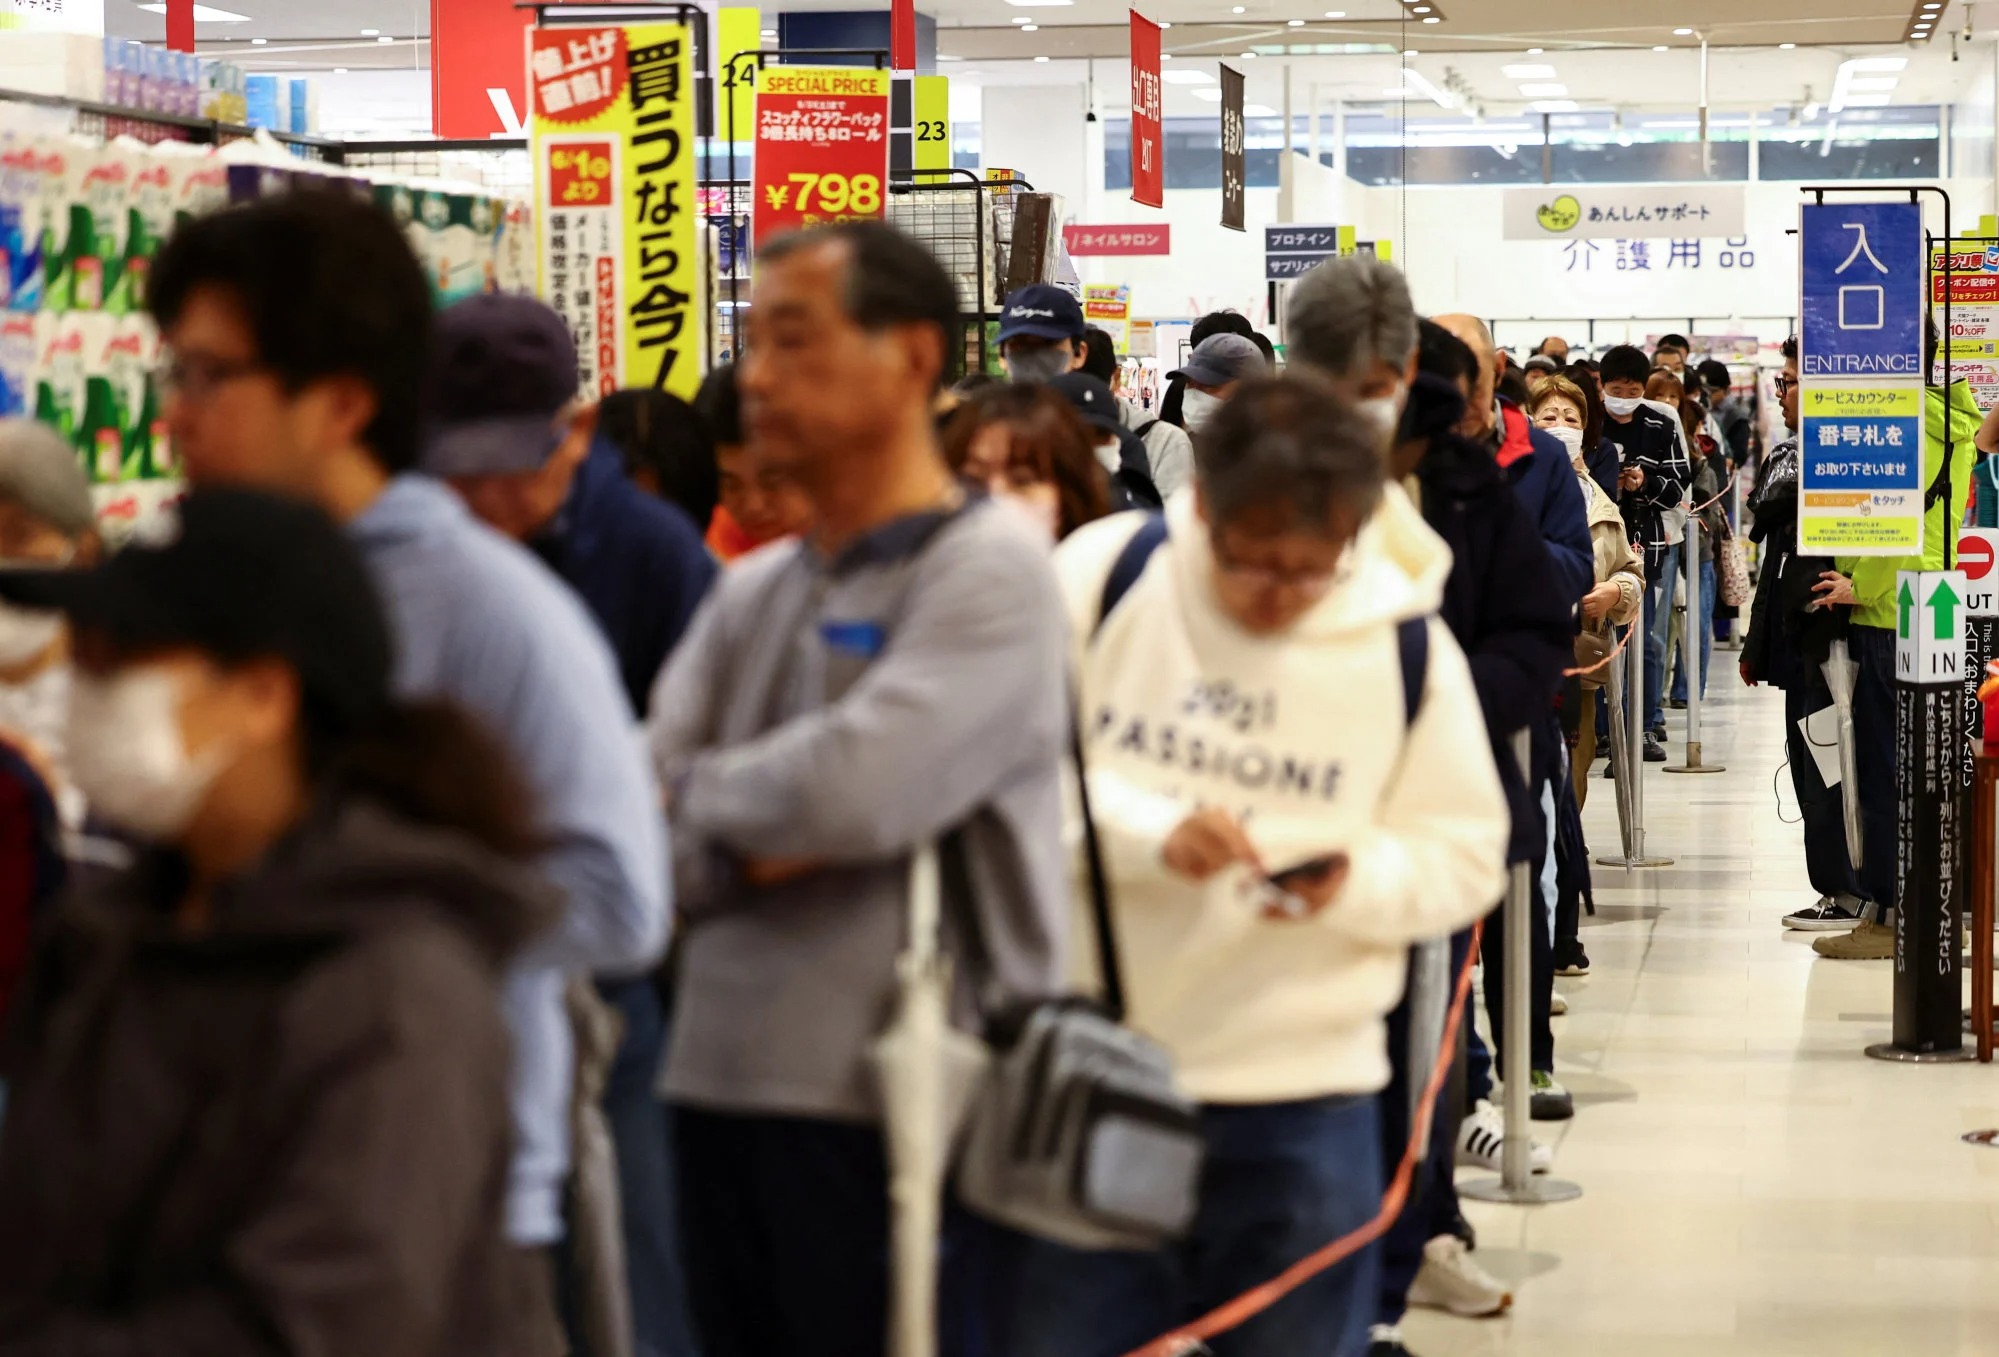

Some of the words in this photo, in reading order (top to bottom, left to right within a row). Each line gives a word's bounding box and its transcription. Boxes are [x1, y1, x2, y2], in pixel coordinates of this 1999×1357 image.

[722, 63, 754, 88] 24
[767, 77, 828, 93] SPECIAL
[832, 79, 879, 93] PRICE
[917, 120, 946, 142] 23
[1081, 233, 1160, 248] ネイルサロン
[1270, 233, 1330, 247] プロテイン
[1564, 237, 1754, 272] 介護用品
[1834, 222, 1889, 330] 入口
[1805, 353, 1918, 372] ENTRANCE
[1814, 392, 1908, 405] サービスカウンター
[1818, 424, 1903, 447] 番号札を
[1814, 462, 1907, 476] お取り下さいませ
[1873, 495, 1905, 506] をタッチ
[1966, 593, 1992, 610] UT
[1982, 622, 1992, 643] This
[1982, 644, 1992, 653] is
[1898, 651, 1910, 674] IN
[1932, 651, 1956, 675] IN
